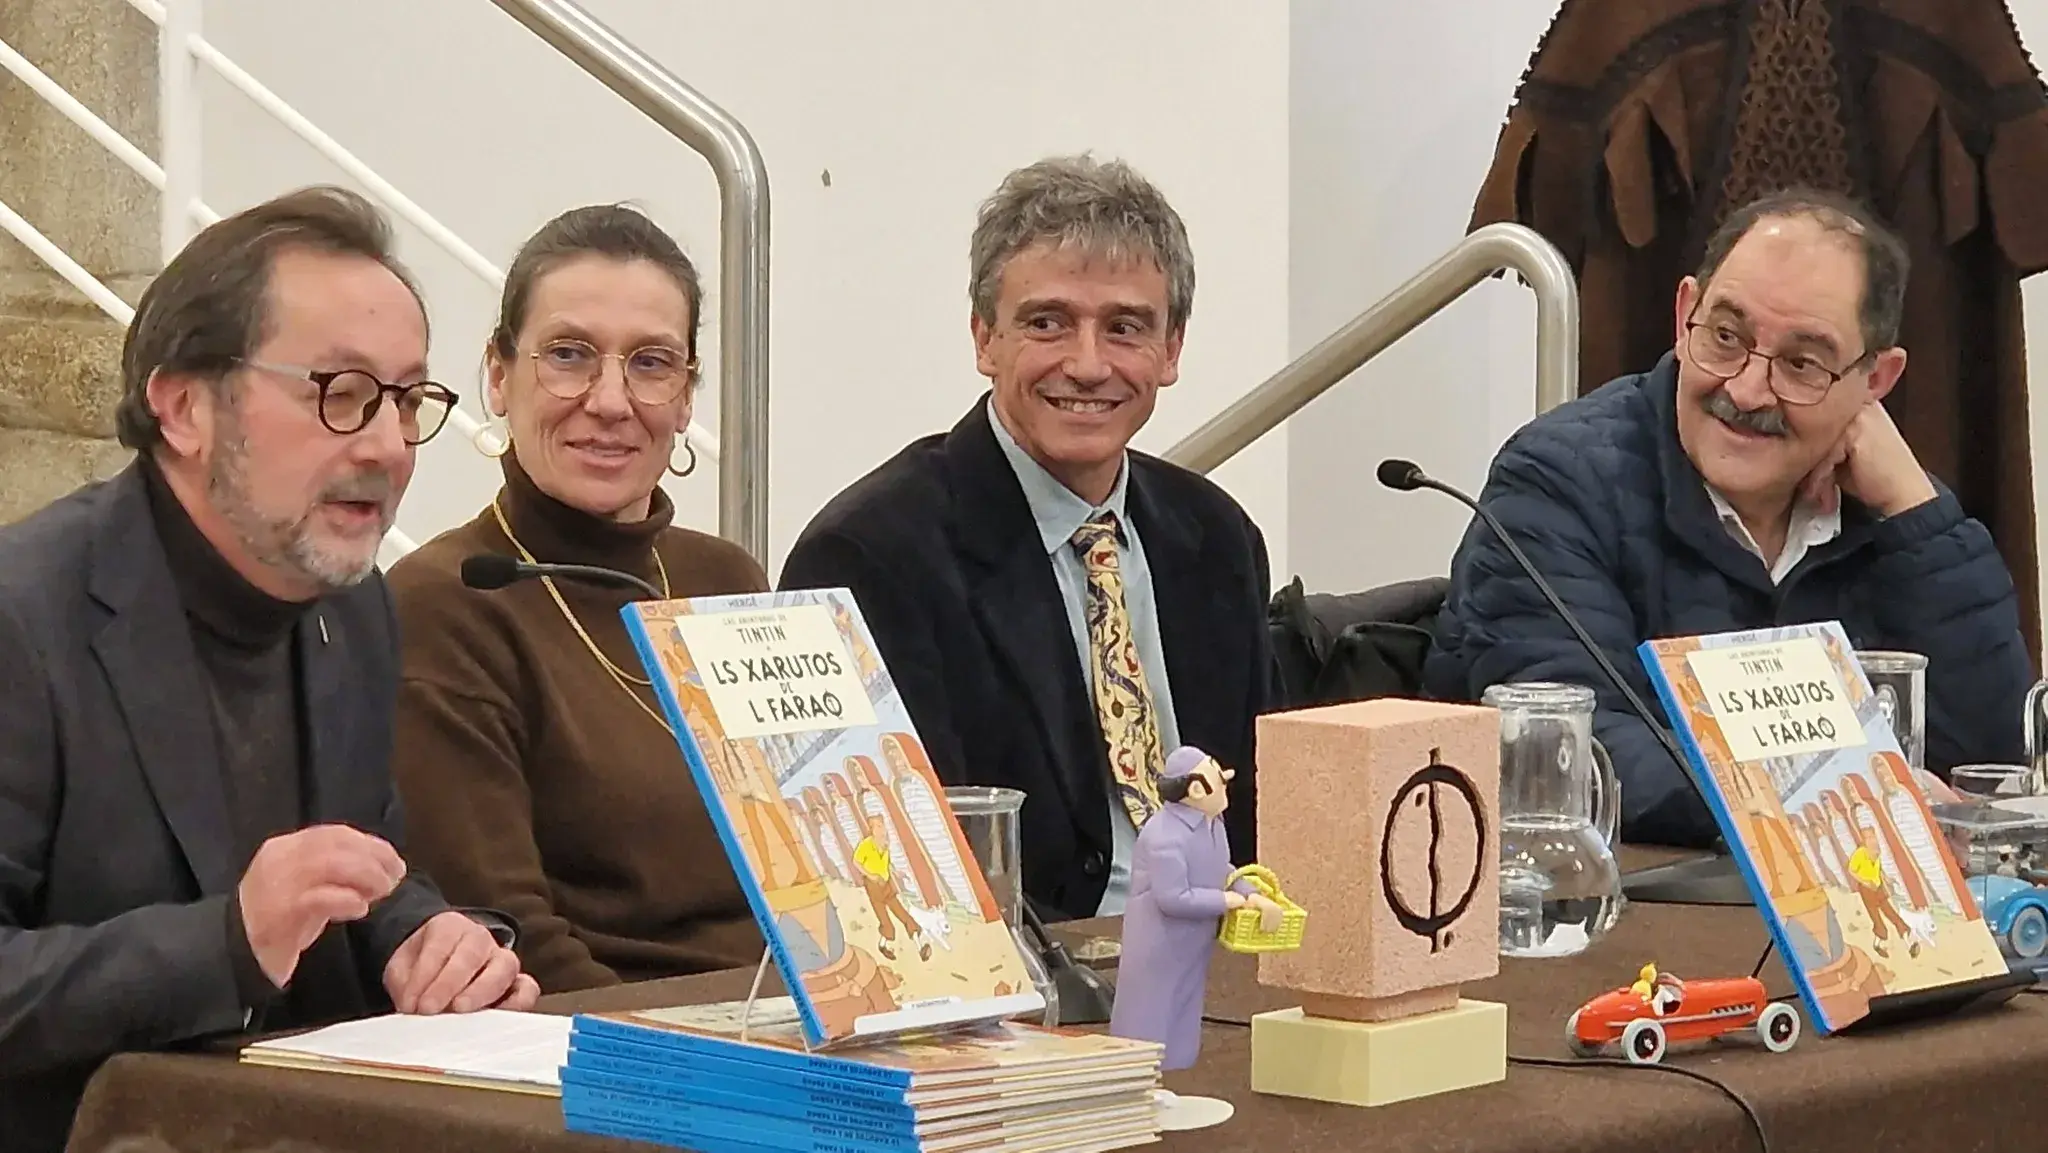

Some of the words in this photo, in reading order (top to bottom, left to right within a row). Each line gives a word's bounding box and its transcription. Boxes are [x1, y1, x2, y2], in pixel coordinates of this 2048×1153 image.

[735, 624, 787, 645] TINTIN
[710, 660, 739, 685] LS
[740, 652, 843, 683] XARUTOS
[1738, 657, 1784, 676] TINTIN
[779, 681, 794, 694] DE
[1718, 692, 1744, 714] LS
[1745, 679, 1836, 710] XARUTOS
[748, 699, 765, 723] L
[1779, 708, 1793, 721] DE
[1753, 725, 1768, 748] L
